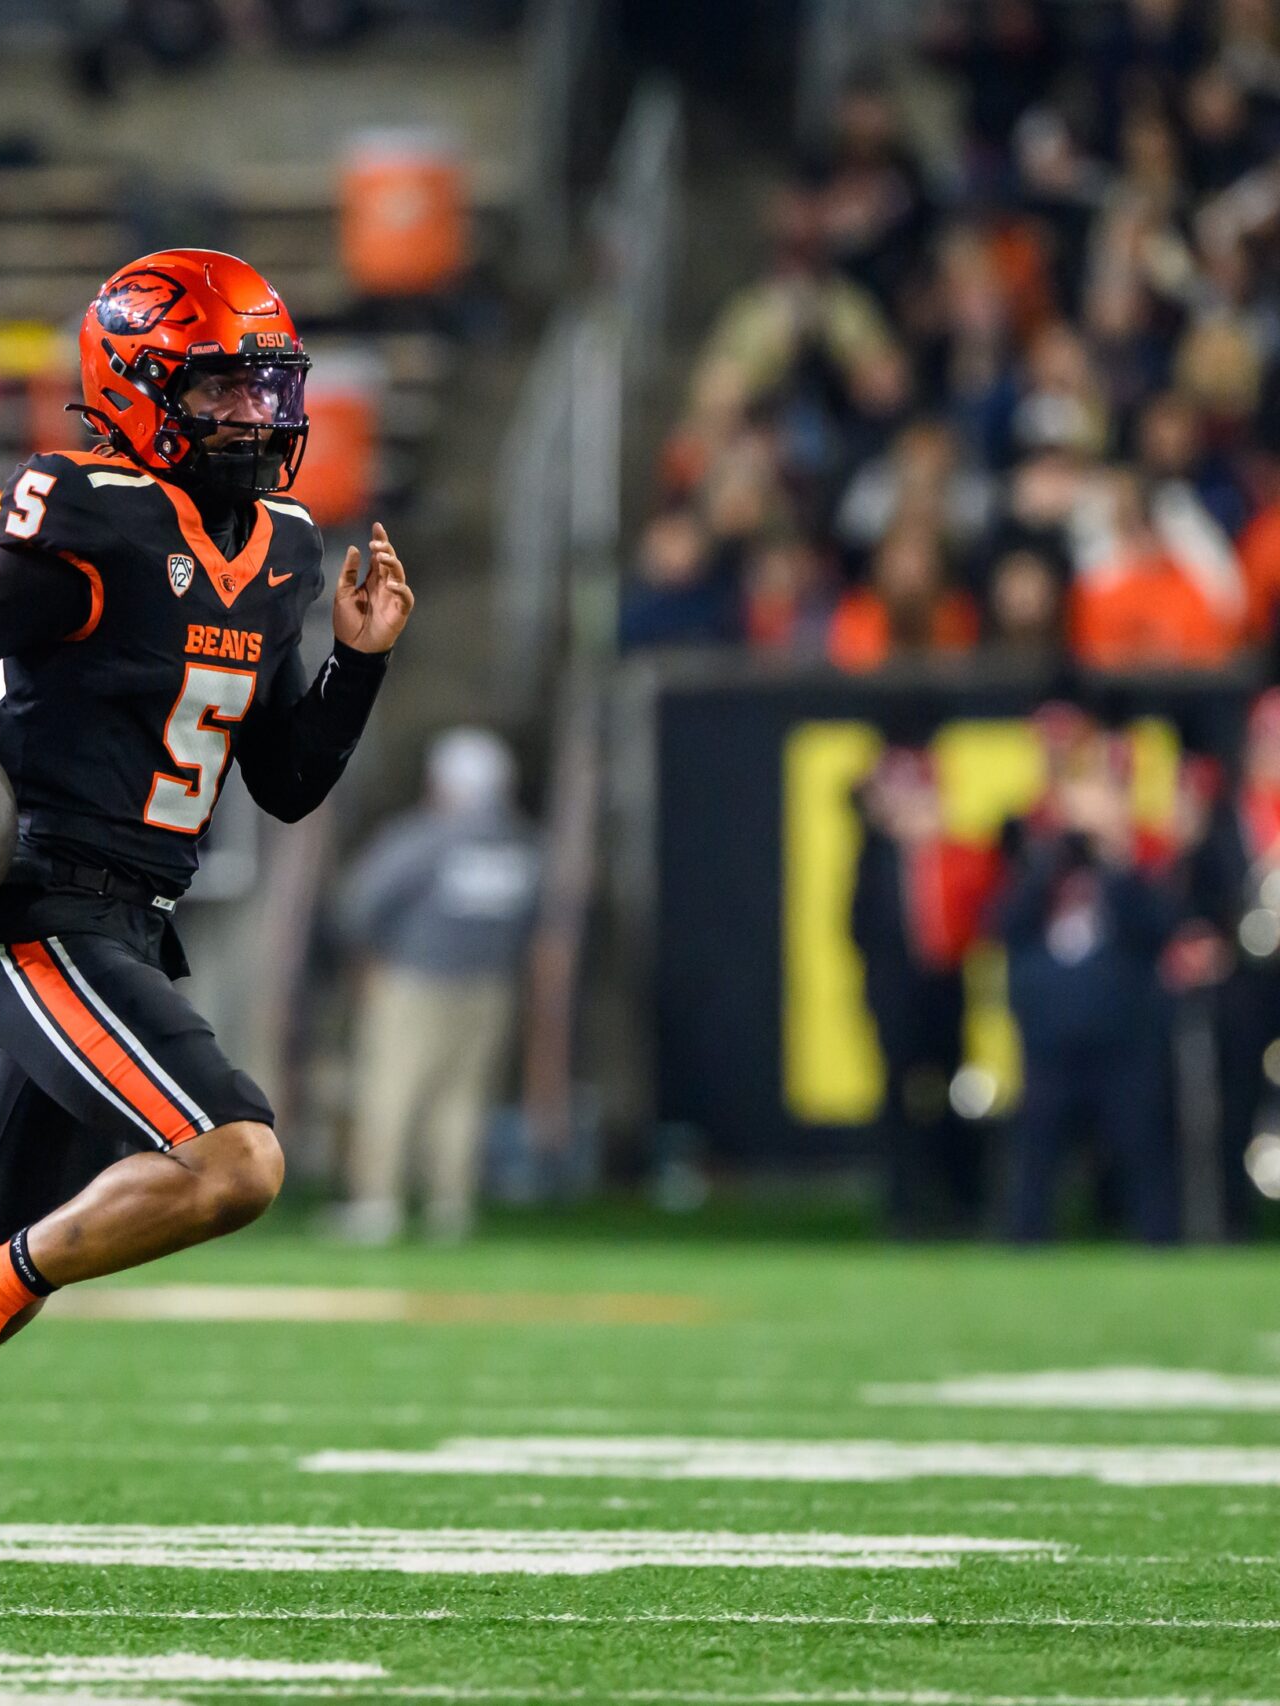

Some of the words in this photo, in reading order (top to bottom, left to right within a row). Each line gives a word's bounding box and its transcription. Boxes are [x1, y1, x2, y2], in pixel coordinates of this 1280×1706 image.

[256, 332, 285, 348] OSU
[5, 468, 58, 540] 5
[170, 556, 193, 579] PAC
[173, 572, 188, 588] 12
[184, 624, 263, 662] BEAVS
[143, 661, 257, 835] 5
